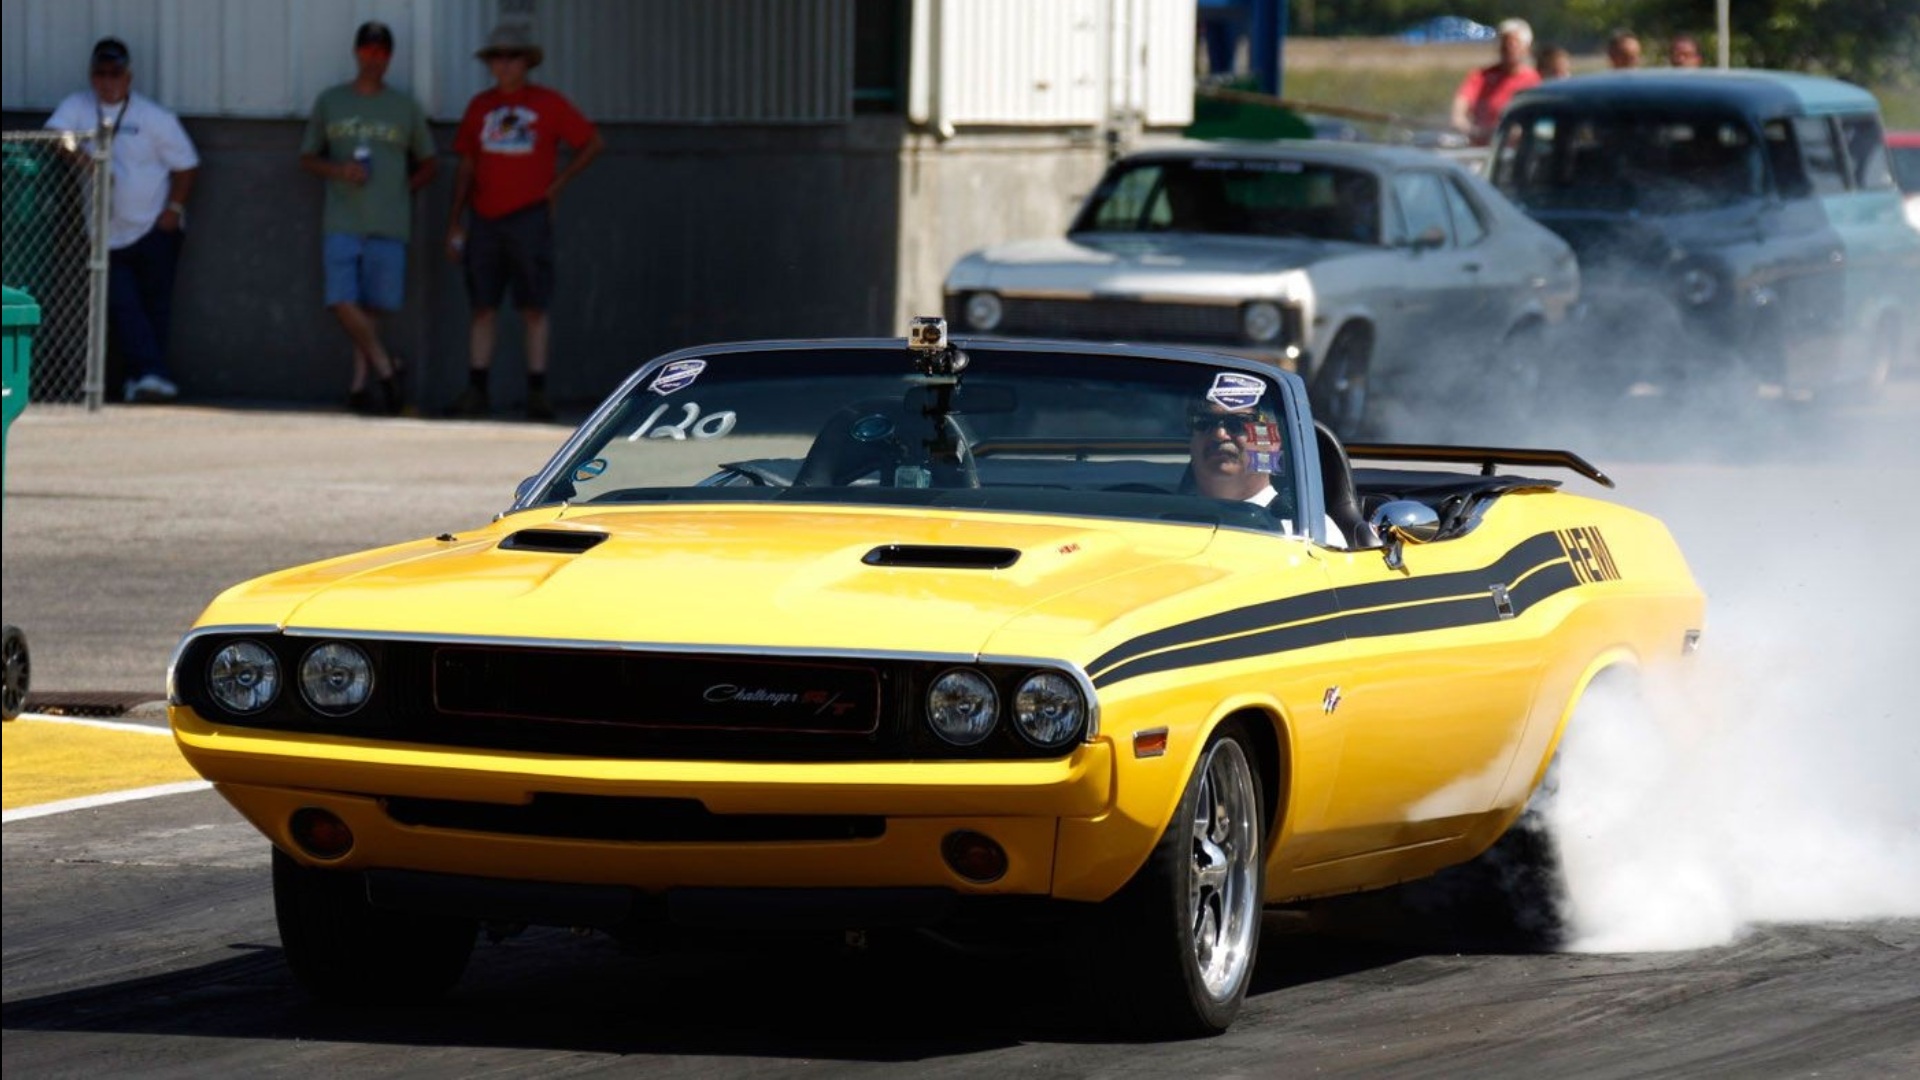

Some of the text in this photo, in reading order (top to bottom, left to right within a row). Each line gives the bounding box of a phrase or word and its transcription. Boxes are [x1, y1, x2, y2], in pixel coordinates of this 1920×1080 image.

[628, 402, 737, 441] 120
[1557, 525, 1622, 584] HEMI
[702, 684, 798, 706] Challenger
